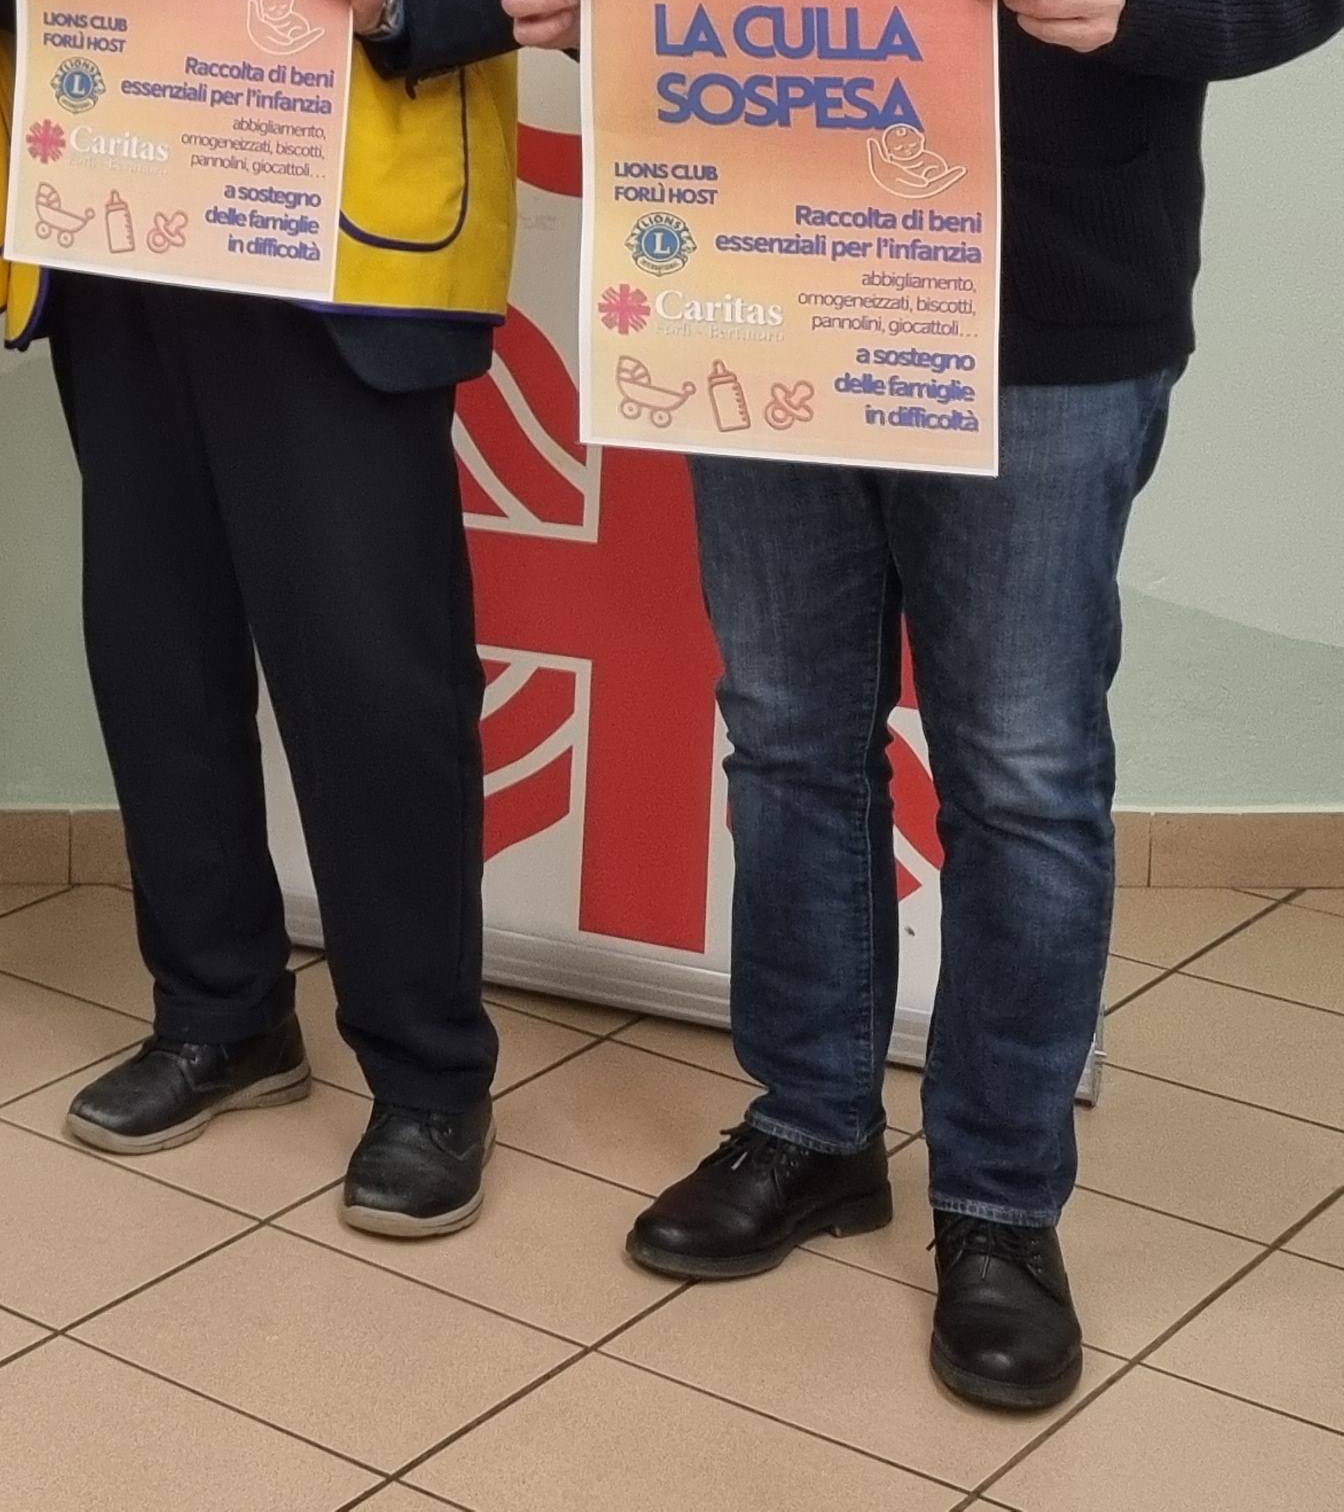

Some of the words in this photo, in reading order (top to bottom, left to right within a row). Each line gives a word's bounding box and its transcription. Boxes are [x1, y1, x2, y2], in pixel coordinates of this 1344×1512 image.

[44, 11, 86, 28] LIONS
[90, 15, 127, 31] CLUB
[654, 3, 726, 58] LA
[732, 4, 923, 61] CULLA
[43, 30, 83, 49] FORLÌ
[87, 36, 126, 52] HOST
[72, 74, 84, 94] L
[184, 56, 265, 81] Raccolta
[268, 64, 286, 83] di
[290, 65, 333, 88] beni
[120, 79, 208, 102] essenziali
[209, 89, 243, 108] per
[246, 88, 330, 114] l'infanzia
[656, 71, 924, 133] SOSPESA
[233, 116, 324, 140] abbigliamento,
[69, 125, 168, 160] Caritas
[181, 133, 272, 155] omogeneizzati,
[276, 140, 323, 160] biscotti,
[190, 154, 248, 172] pannolini,
[614, 162, 668, 179] LIONS
[670, 164, 718, 181] CLUB
[224, 184, 235, 198] a
[239, 185, 320, 210] sostegno
[614, 182, 665, 202] FORLÌ
[668, 187, 718, 204] HOST
[205, 205, 246, 227] delle
[249, 209, 318, 237] famiglie
[639, 214, 683, 231] LIONS
[795, 204, 897, 229] Raccolta
[901, 208, 923, 230] di
[928, 209, 981, 233] beni
[227, 234, 248, 253] in
[248, 235, 319, 261] difficoltà
[653, 232, 669, 254] L
[715, 234, 826, 255] essenziali
[831, 240, 872, 261] per
[876, 238, 981, 263] l'infanzia
[861, 270, 976, 293] abbigliamento,
[655, 289, 782, 324] Caritas
[797, 292, 912, 312] omogeneizzati,
[916, 295, 975, 315] biscotti,
[811, 314, 885, 333] pannolini,
[856, 347, 870, 363] a
[873, 347, 975, 373] sostegno
[834, 372, 886, 395] delle
[887, 375, 975, 404] famiglie
[865, 404, 890, 425] in
[889, 405, 978, 432] difficoltà
